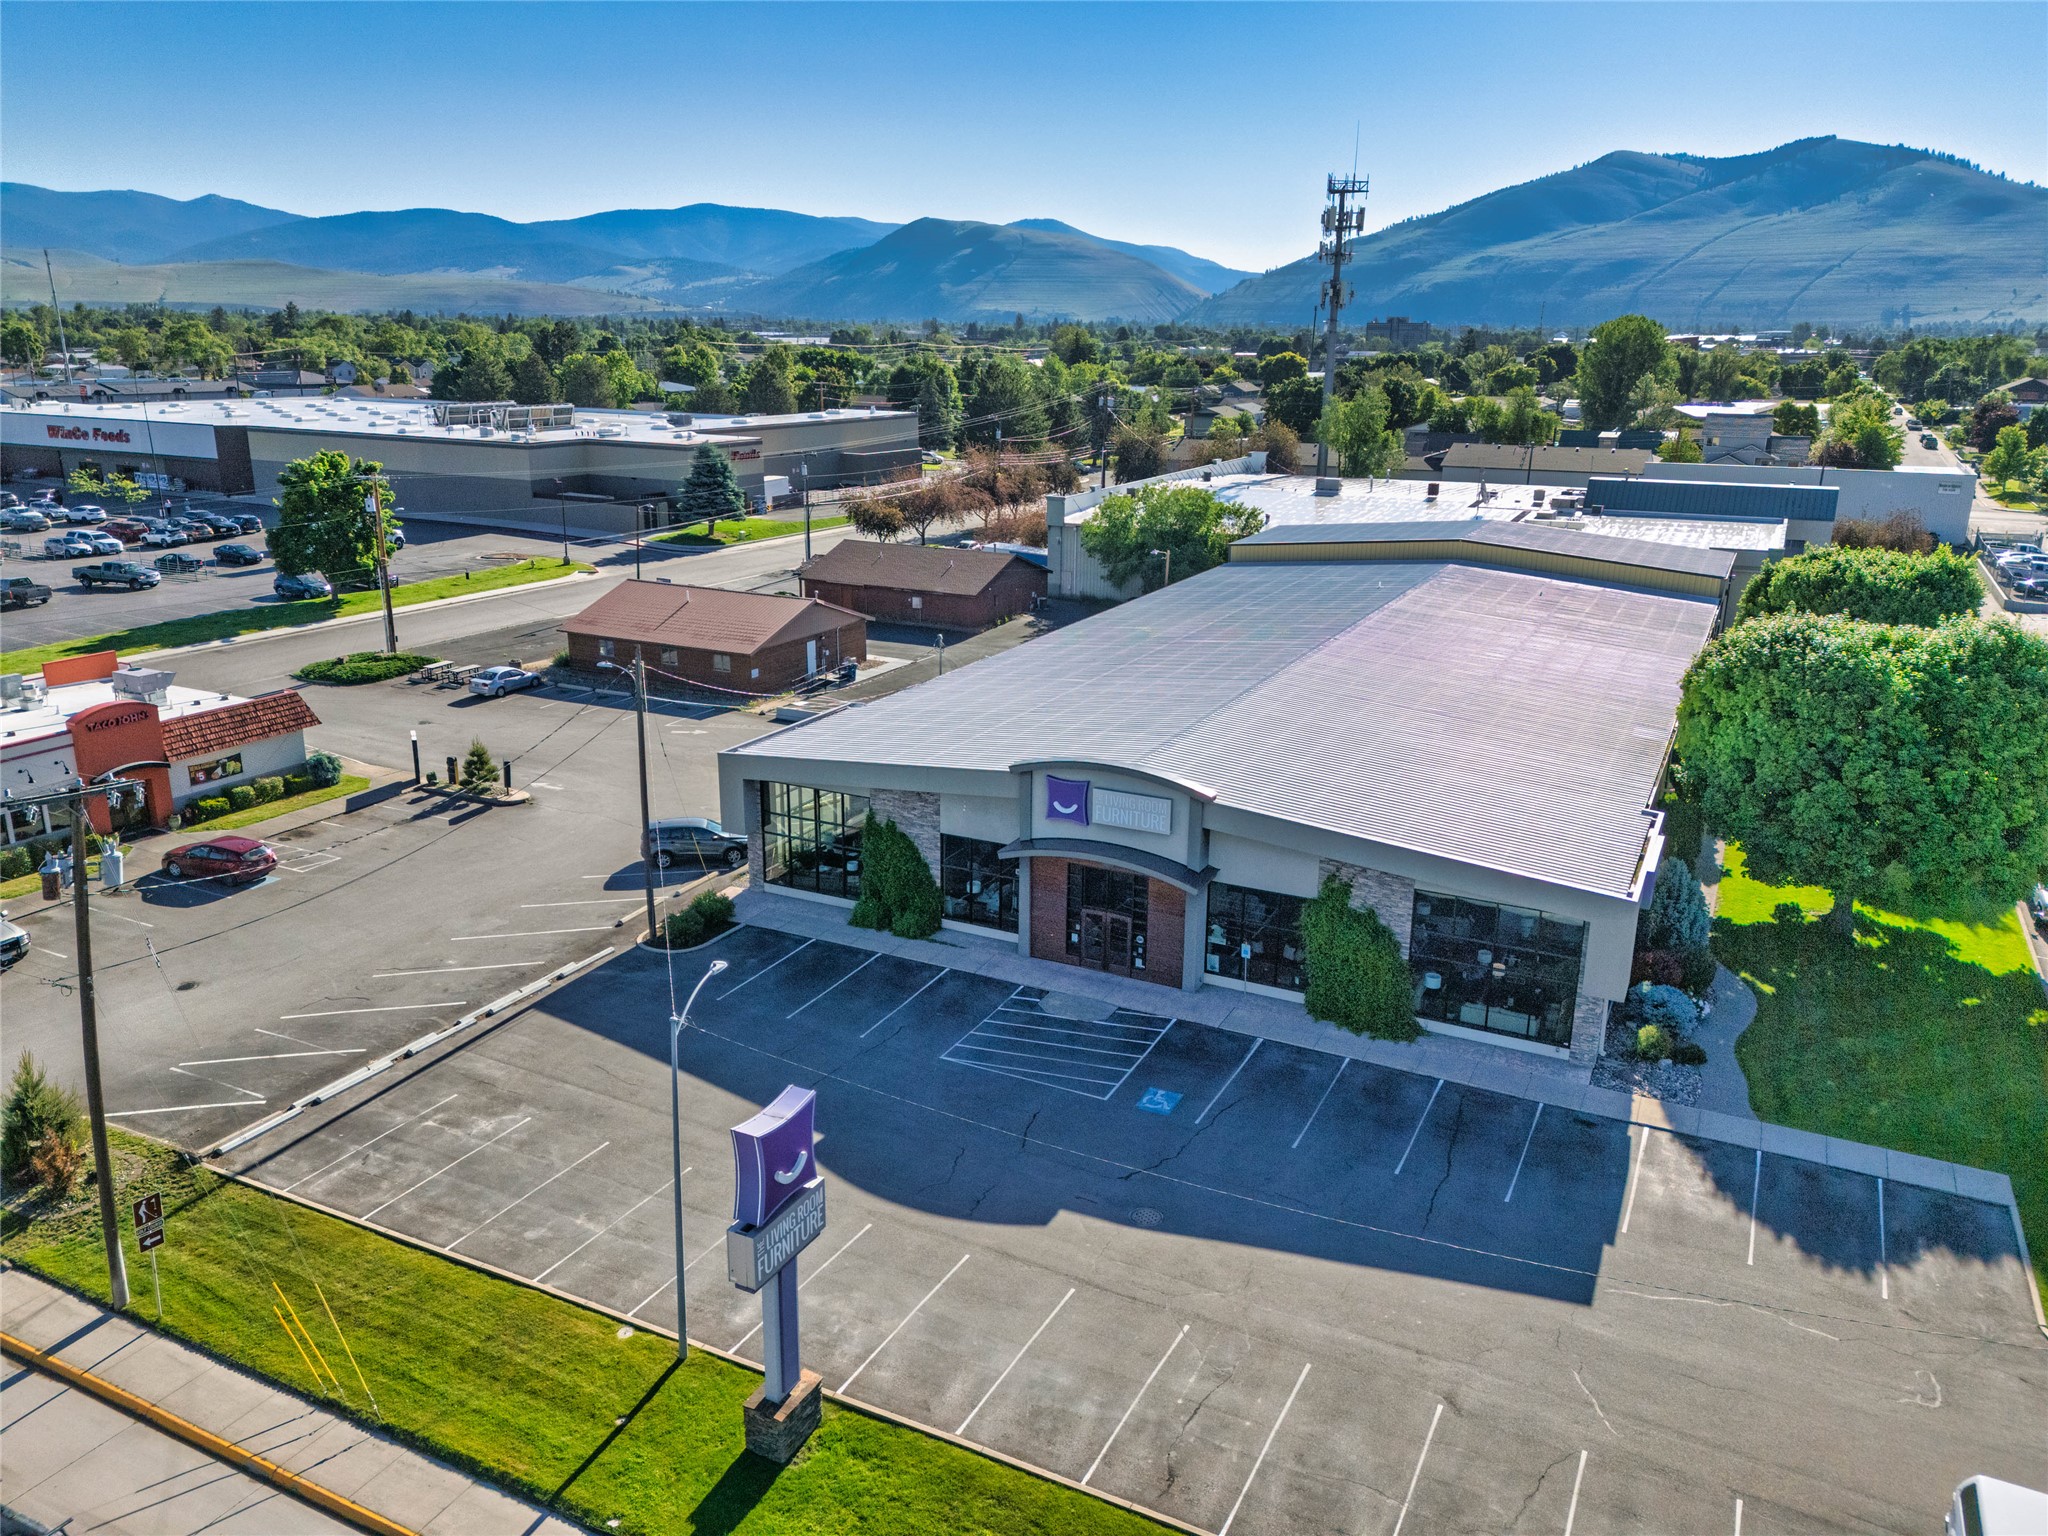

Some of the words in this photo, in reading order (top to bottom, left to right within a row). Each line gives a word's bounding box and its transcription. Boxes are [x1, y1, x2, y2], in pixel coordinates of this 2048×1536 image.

[46, 425, 90, 441] WinCo
[92, 427, 131, 443] Foods
[86, 717, 117, 732] TACO
[1105, 794, 1136, 811] LIVING
[1138, 800, 1168, 815] ROOM
[1095, 804, 1167, 832] FURNITURE
[766, 1212, 796, 1250] LIVING
[797, 1187, 824, 1223] ROOM
[757, 1203, 824, 1281] FURNITURE
